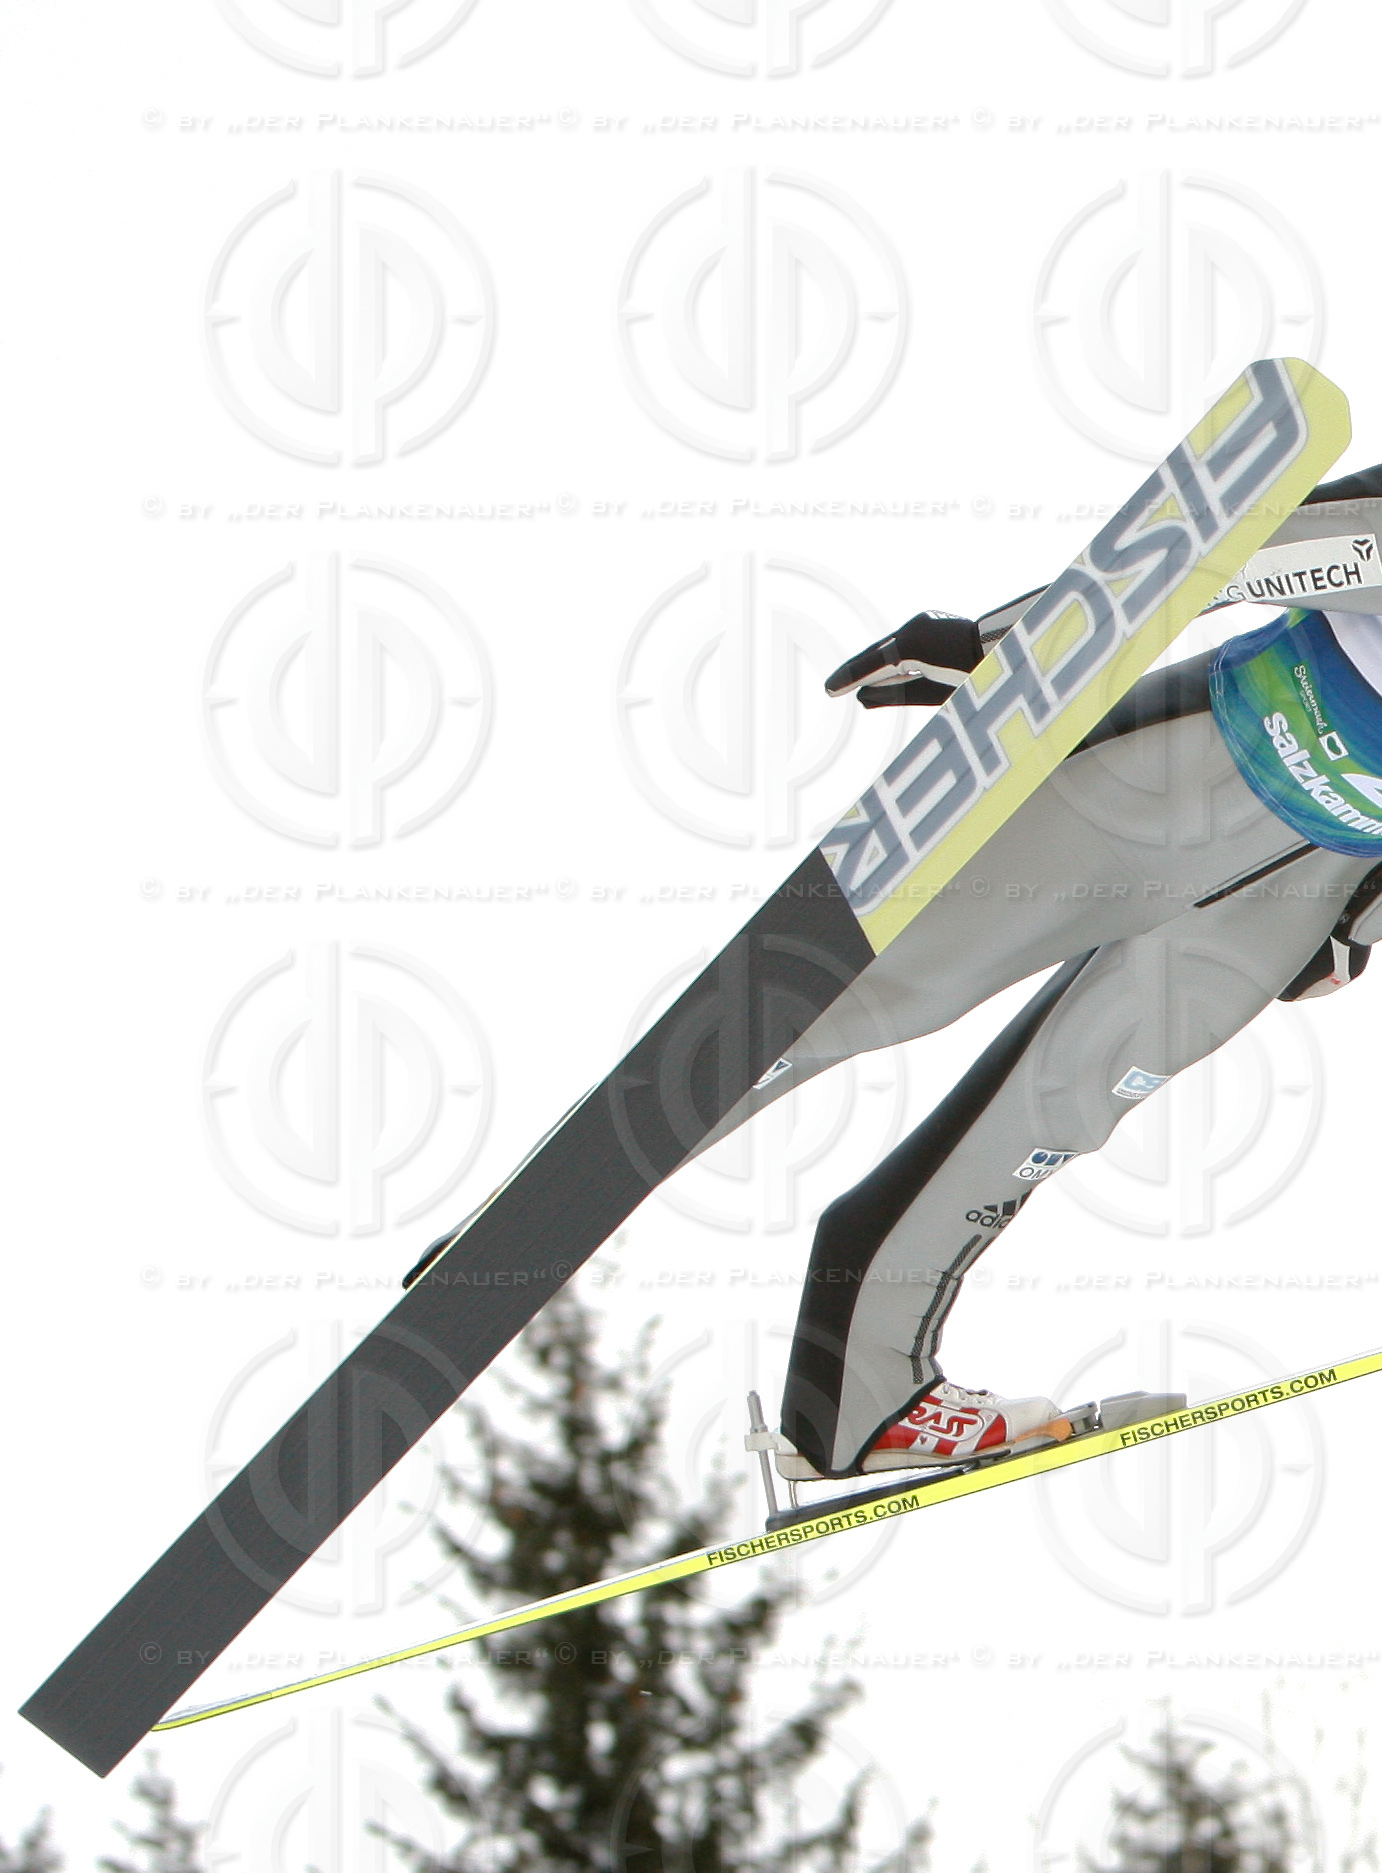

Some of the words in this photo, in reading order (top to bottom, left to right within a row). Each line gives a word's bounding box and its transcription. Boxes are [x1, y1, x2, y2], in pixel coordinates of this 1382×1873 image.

[1246, 562, 1363, 598] UNITECH
[822, 358, 1308, 914] FISCHER
[1119, 1368, 1338, 1447] FISCHERSPORTS.COM
[706, 1494, 920, 1566] FISCHERSPORTS.COM
